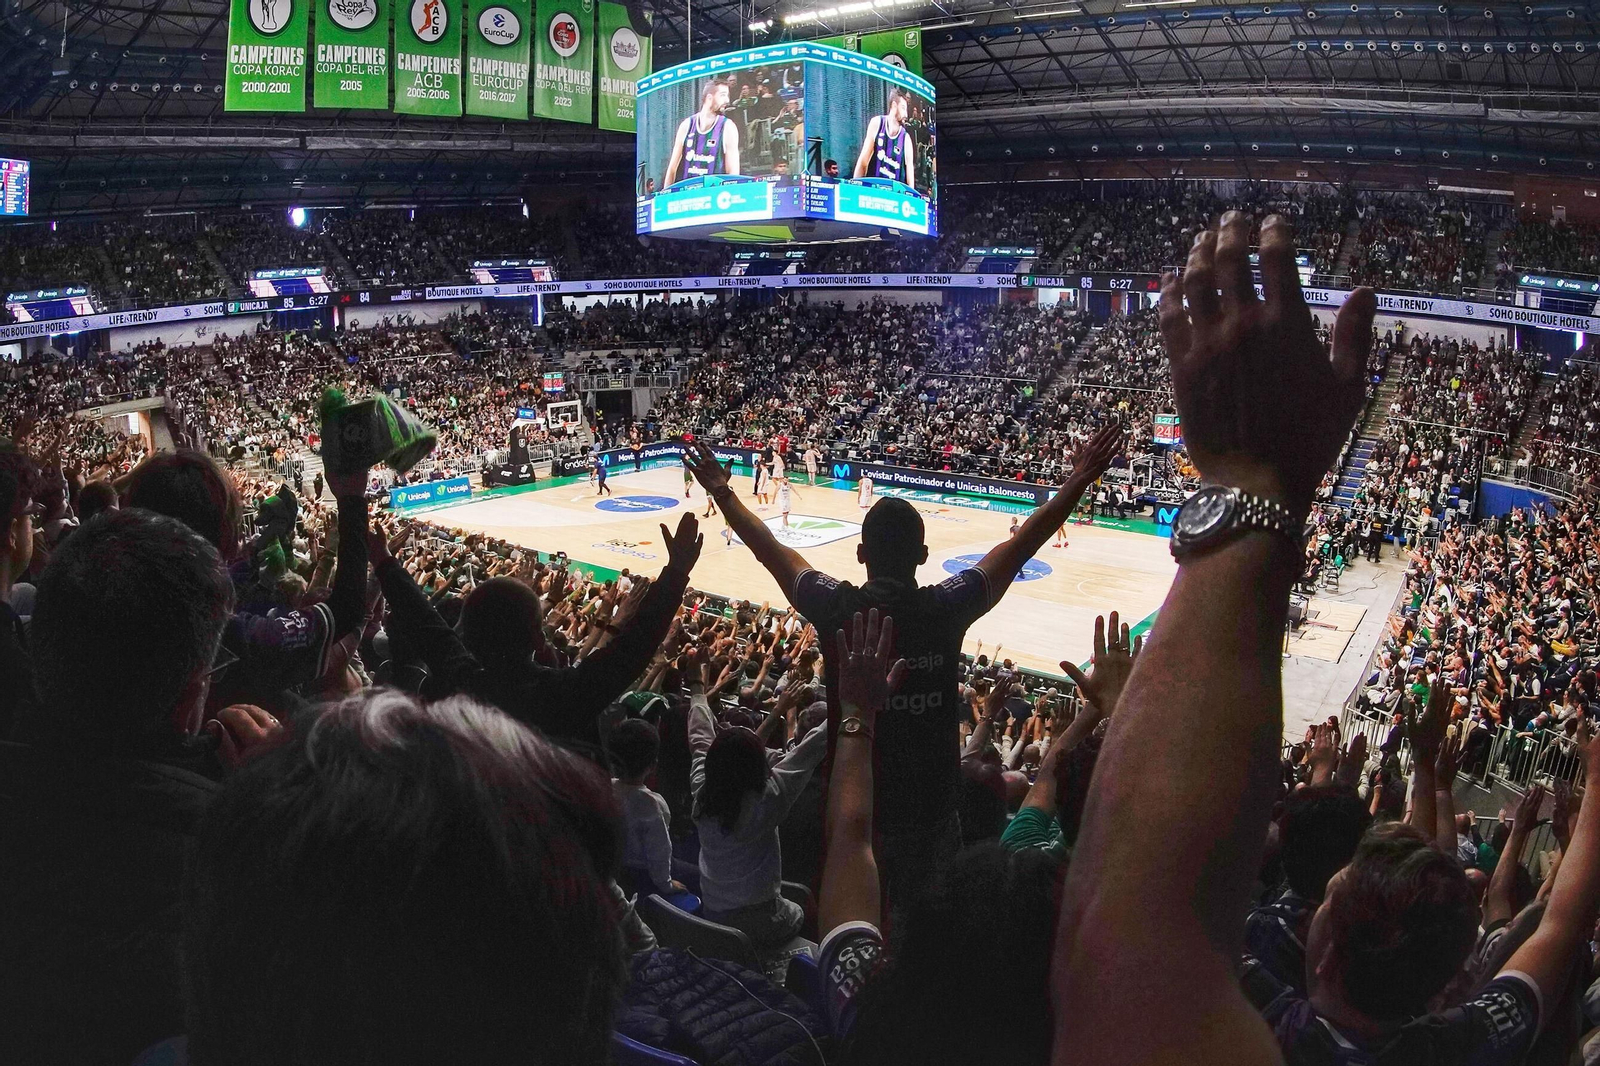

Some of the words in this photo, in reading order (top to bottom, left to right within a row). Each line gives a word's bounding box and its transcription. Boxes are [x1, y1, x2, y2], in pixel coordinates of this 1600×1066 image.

[484, 27, 514, 39] EuroCup
[230, 44, 304, 65] CAMPEONES
[317, 44, 386, 65] CAMPEONES
[316, 63, 342, 74] COPA
[345, 65, 364, 74] DEL
[367, 66, 387, 75] REY
[397, 52, 460, 75] CAMPEONES
[469, 56, 527, 79] CAMPEONES
[233, 64, 262, 75] COPA
[264, 65, 300, 76] KORAC
[536, 63, 591, 86] CAMPEONES
[340, 80, 362, 91] 2005
[413, 73, 443, 88] ACB
[472, 74, 523, 90] EUROCUP
[242, 82, 290, 93] 2000/2001
[535, 79, 557, 89] COPA
[558, 84, 574, 93] DEL
[575, 85, 591, 95] REY
[407, 87, 450, 99] 2005/2006
[479, 90, 516, 103] 2016/2017
[554, 96, 572, 107] 2023
[619, 98, 634, 108] BCL
[617, 108, 634, 119] 2024
[604, 281, 622, 289] SOHO
[623, 281, 657, 289] BOUTIQUE
[658, 280, 683, 288] HOTELS
[735, 277, 760, 286] TRENDY
[799, 277, 815, 285] SOHO
[816, 276, 847, 284] BOUTIQUE
[848, 276, 871, 284] HOTELS
[925, 275, 952, 284] TRENDY
[997, 277, 1017, 285] SOHO
[1034, 277, 1065, 287] UNICAJA
[1081, 277, 1093, 289] 85
[1110, 278, 1133, 289] 6:27
[1529, 278, 1546, 286] Unicaja
[534, 284, 561, 292] TRENDY
[1564, 282, 1581, 290] Unicaja
[360, 292, 370, 303] 84
[427, 288, 459, 297] BOUTIQUE
[460, 287, 483, 296] HOTELS
[240, 301, 268, 311] UNICAJA
[284, 298, 294, 308] 85
[309, 296, 329, 306] 6:27
[1400, 299, 1434, 311] TRENDY
[204, 305, 224, 315] SOHO
[129, 311, 158, 323] TRENDY
[1489, 308, 1514, 320] SOHO
[1515, 312, 1558, 326] BOUTIQUE
[1557, 317, 1590, 330] HOTELS
[11, 324, 44, 337] BOUTIQUE
[45, 321, 70, 333] HOTELS
[1156, 425, 1172, 438] 24
[645, 446, 680, 457] Patrocinador
[712, 450, 743, 460] aloncesto
[446, 484, 469, 494] Unicaja
[894, 473, 943, 488] Patrocinador
[945, 480, 956, 489] de
[957, 481, 987, 493] Unicaja
[988, 486, 1035, 500] Baloncesto
[407, 491, 431, 501] Unicaja
[1154, 490, 1181, 499] endesa
[900, 651, 944, 672] caja
[885, 691, 943, 715] laga
